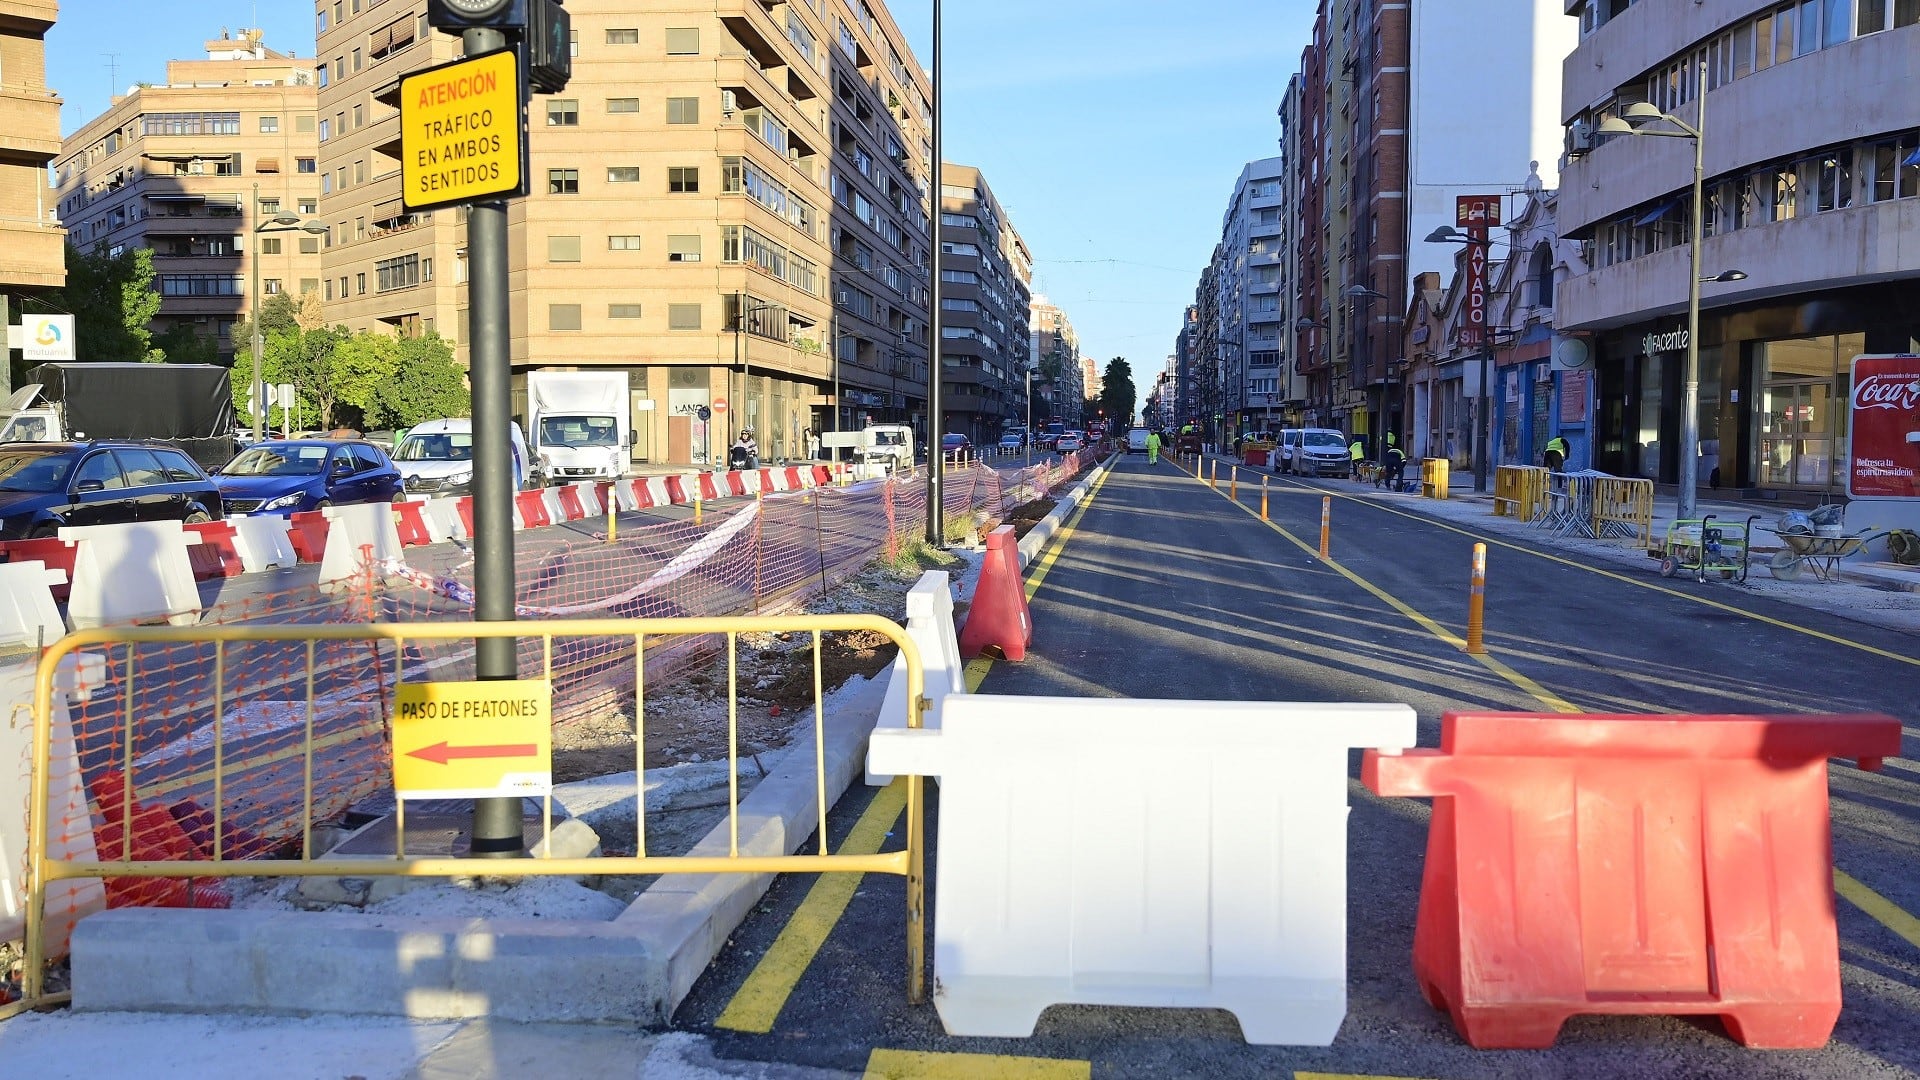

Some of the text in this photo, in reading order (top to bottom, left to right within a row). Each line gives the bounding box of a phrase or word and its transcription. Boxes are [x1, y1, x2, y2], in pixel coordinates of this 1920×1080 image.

[418, 69, 497, 109] ATENCIÓN
[424, 109, 492, 140] TRÁFICO
[418, 134, 500, 167] EN AMBOS
[420, 162, 500, 193] SENTIDOS
[1642, 323, 1689, 357] SOFAcente
[1856, 458, 1894, 467] Refresca tu
[402, 699, 538, 720] PASO DE PEATONES
